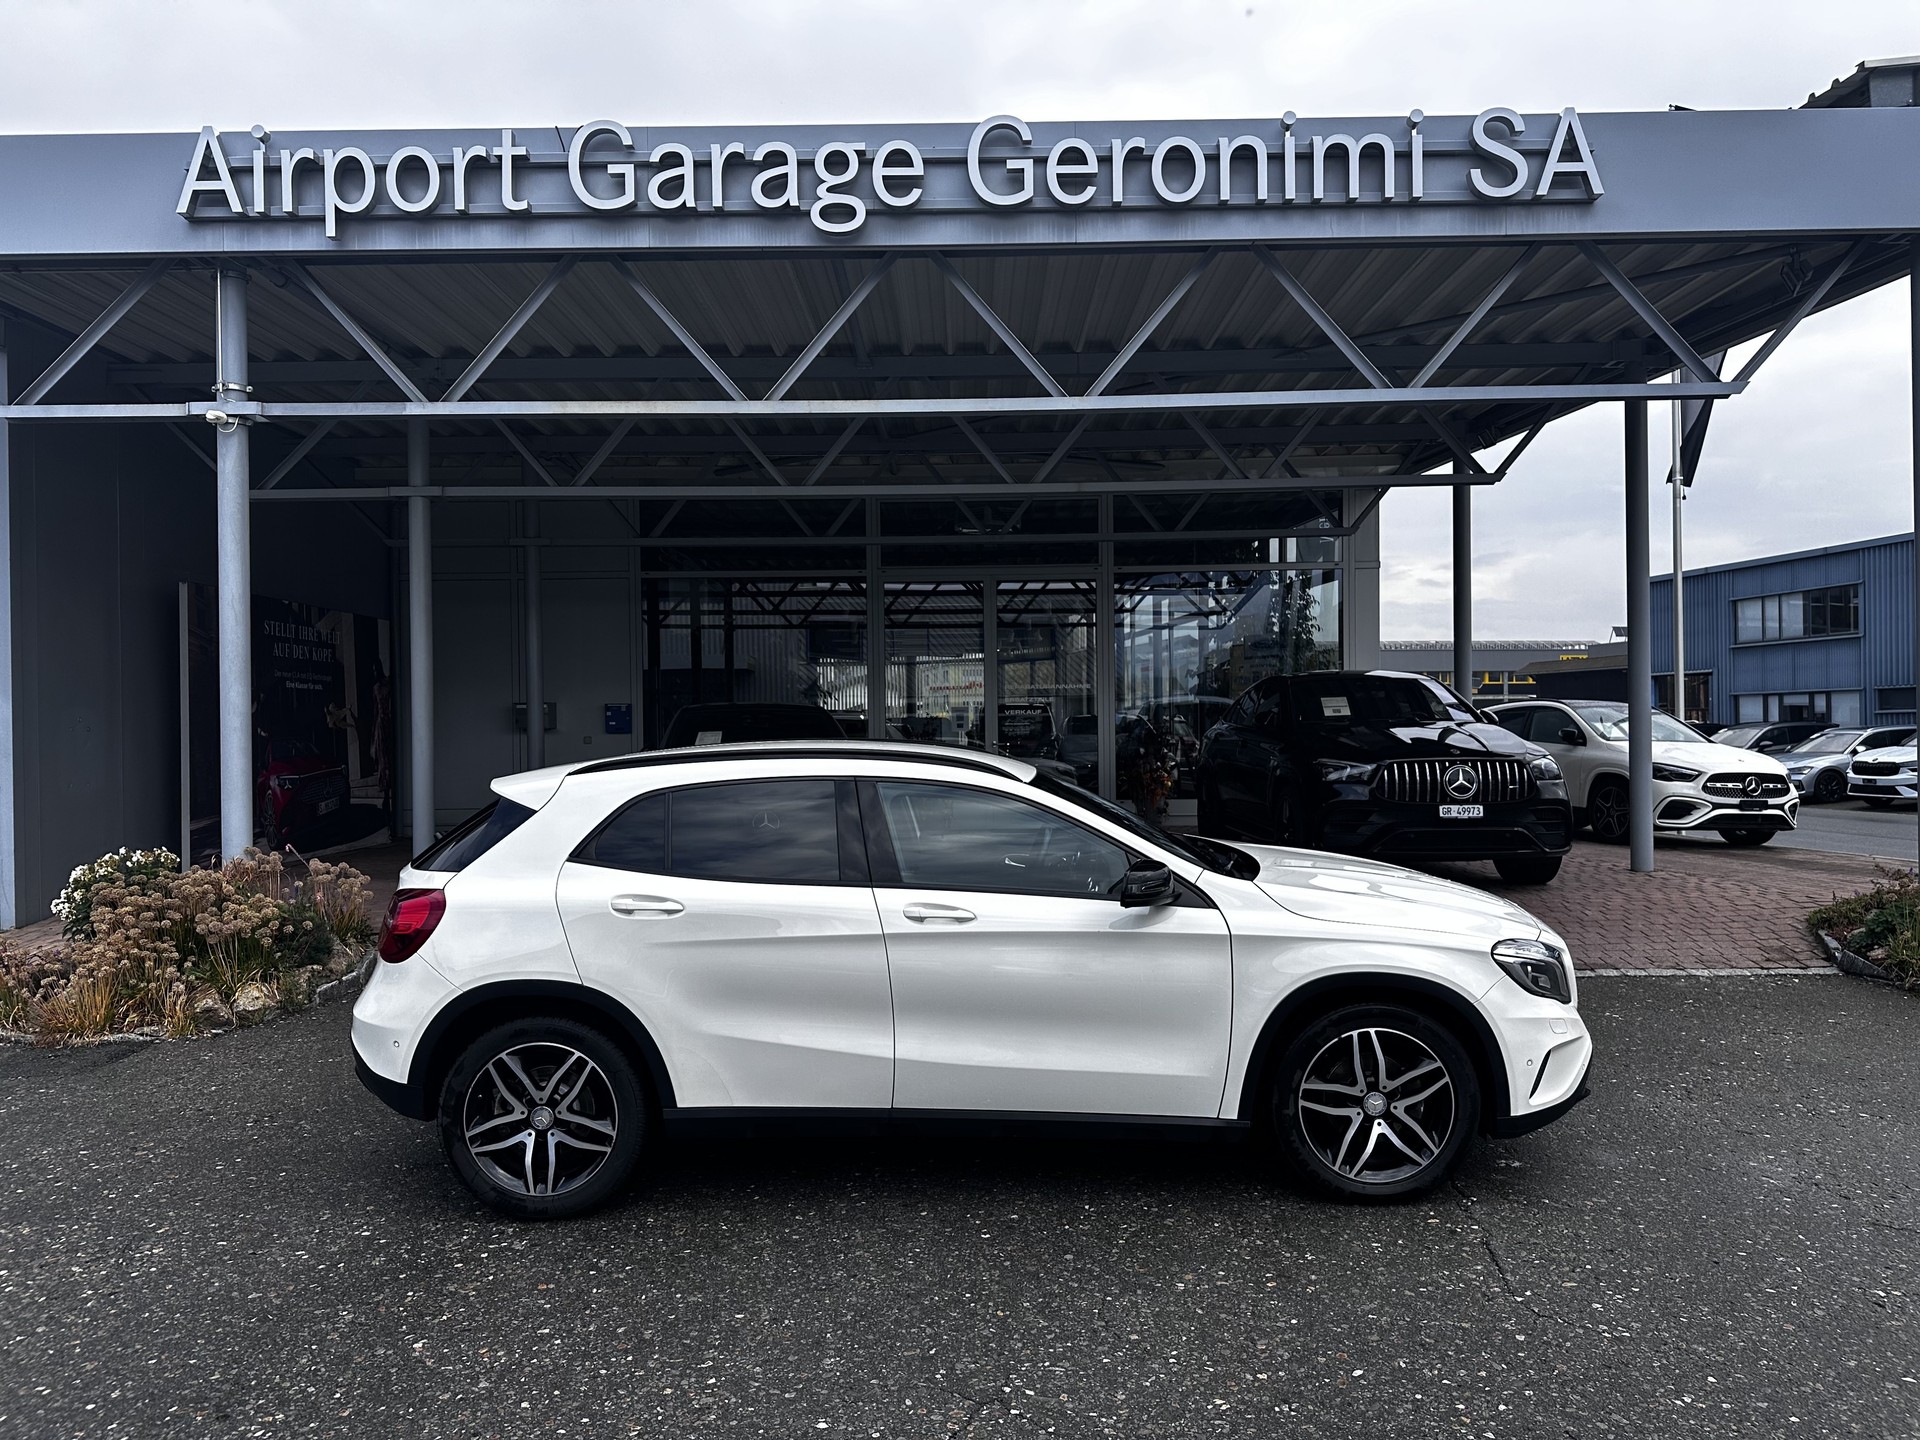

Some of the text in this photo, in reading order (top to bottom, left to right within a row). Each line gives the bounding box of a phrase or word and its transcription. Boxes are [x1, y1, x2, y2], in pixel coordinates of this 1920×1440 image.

[175, 106, 1605, 241] Airport Garage Geronimi SA
[264, 619, 341, 645] STELLT IHRE WELT
[273, 642, 335, 663] AUF DEN KOPF.
